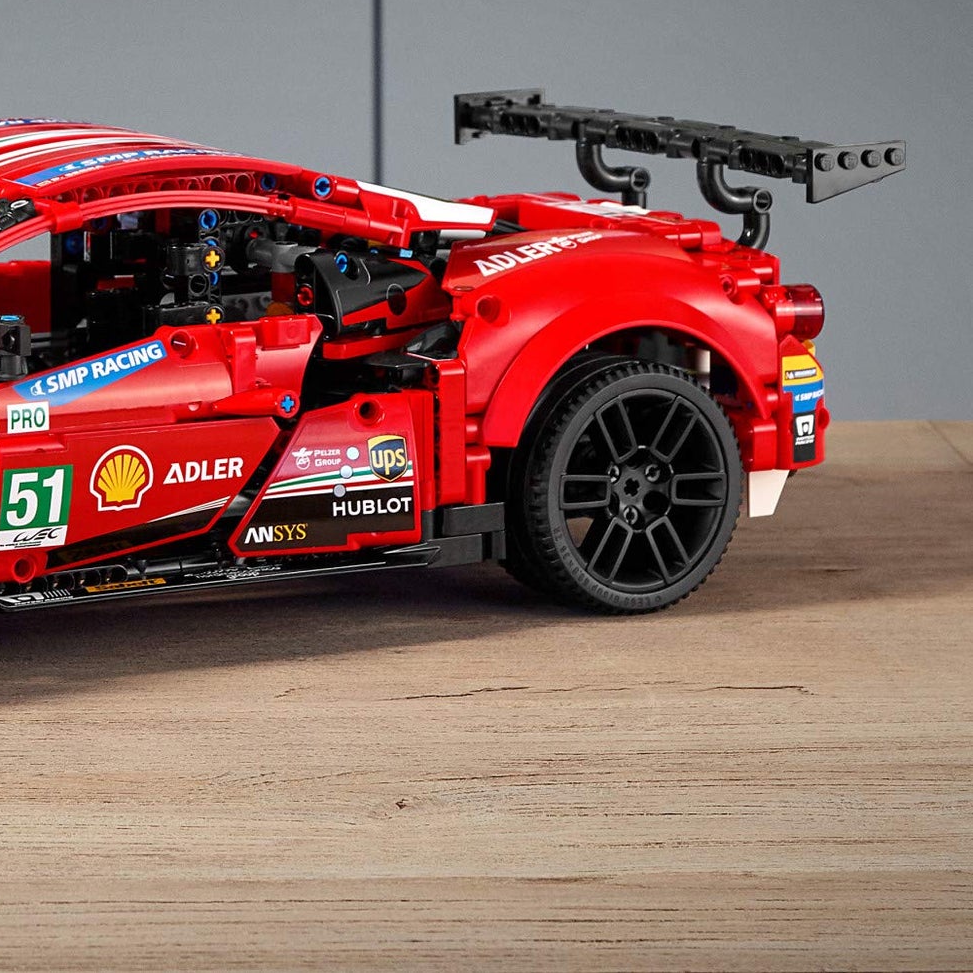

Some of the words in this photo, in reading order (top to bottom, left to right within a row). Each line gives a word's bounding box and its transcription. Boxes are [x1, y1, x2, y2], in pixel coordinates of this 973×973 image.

[473, 239, 560, 277] ADLER
[47, 367, 89, 394] SMP
[92, 343, 163, 379] RACING
[11, 407, 46, 430] PRO
[313, 449, 341, 457] PELZER
[315, 457, 342, 467] GROUP
[371, 448, 406, 476] ups
[163, 457, 244, 485] ADLER
[6, 468, 65, 527] 51
[332, 496, 413, 518] HUBLOT
[13, 527, 63, 543] WEC
[244, 524, 307, 544] ANSYS
